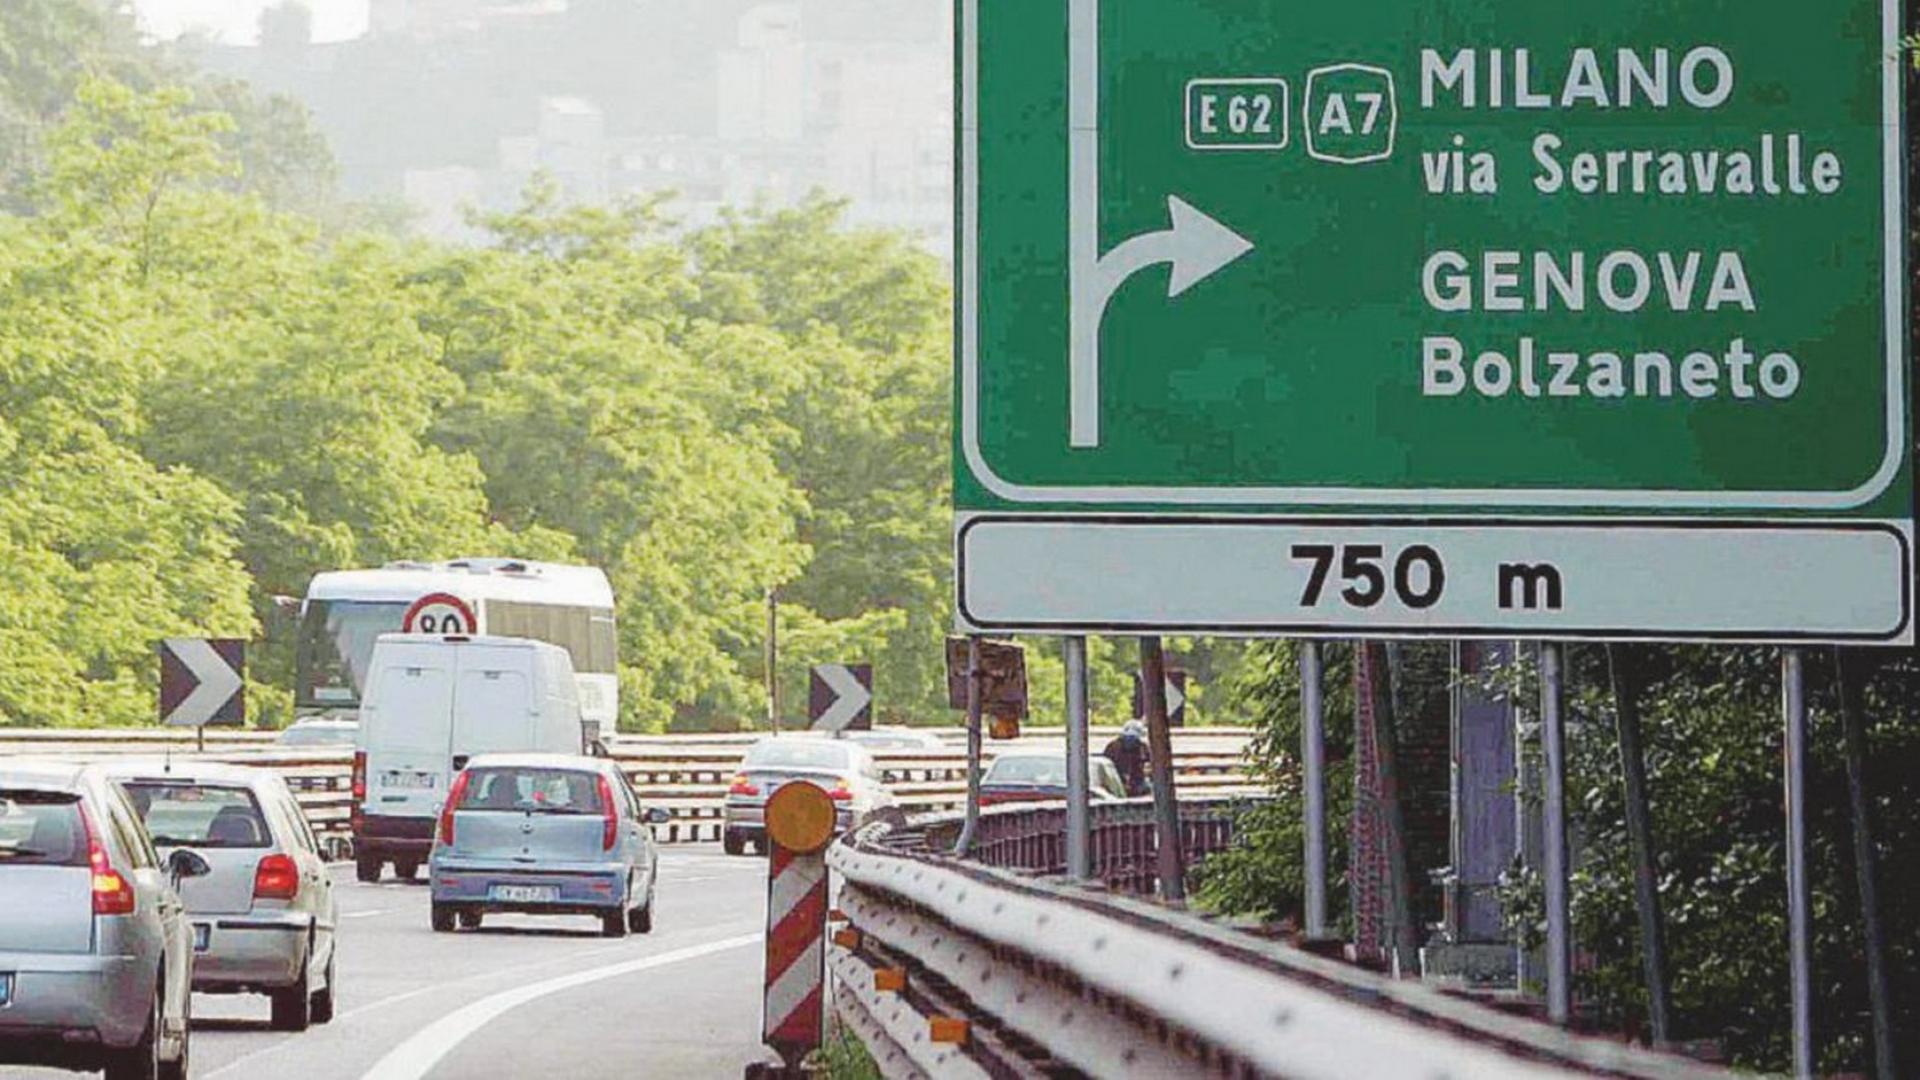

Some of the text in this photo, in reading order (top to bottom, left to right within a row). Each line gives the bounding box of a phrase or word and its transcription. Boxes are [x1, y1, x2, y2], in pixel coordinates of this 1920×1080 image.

[1421, 47, 1733, 108] MILANO
[1200, 94, 1271, 133] E 62
[1319, 93, 1382, 134] A7
[1422, 133, 1841, 194] via Serravalle
[1422, 250, 1755, 312] GENOVA
[1423, 336, 1799, 398] Bolzaneto
[1291, 544, 1562, 610] 750 m
